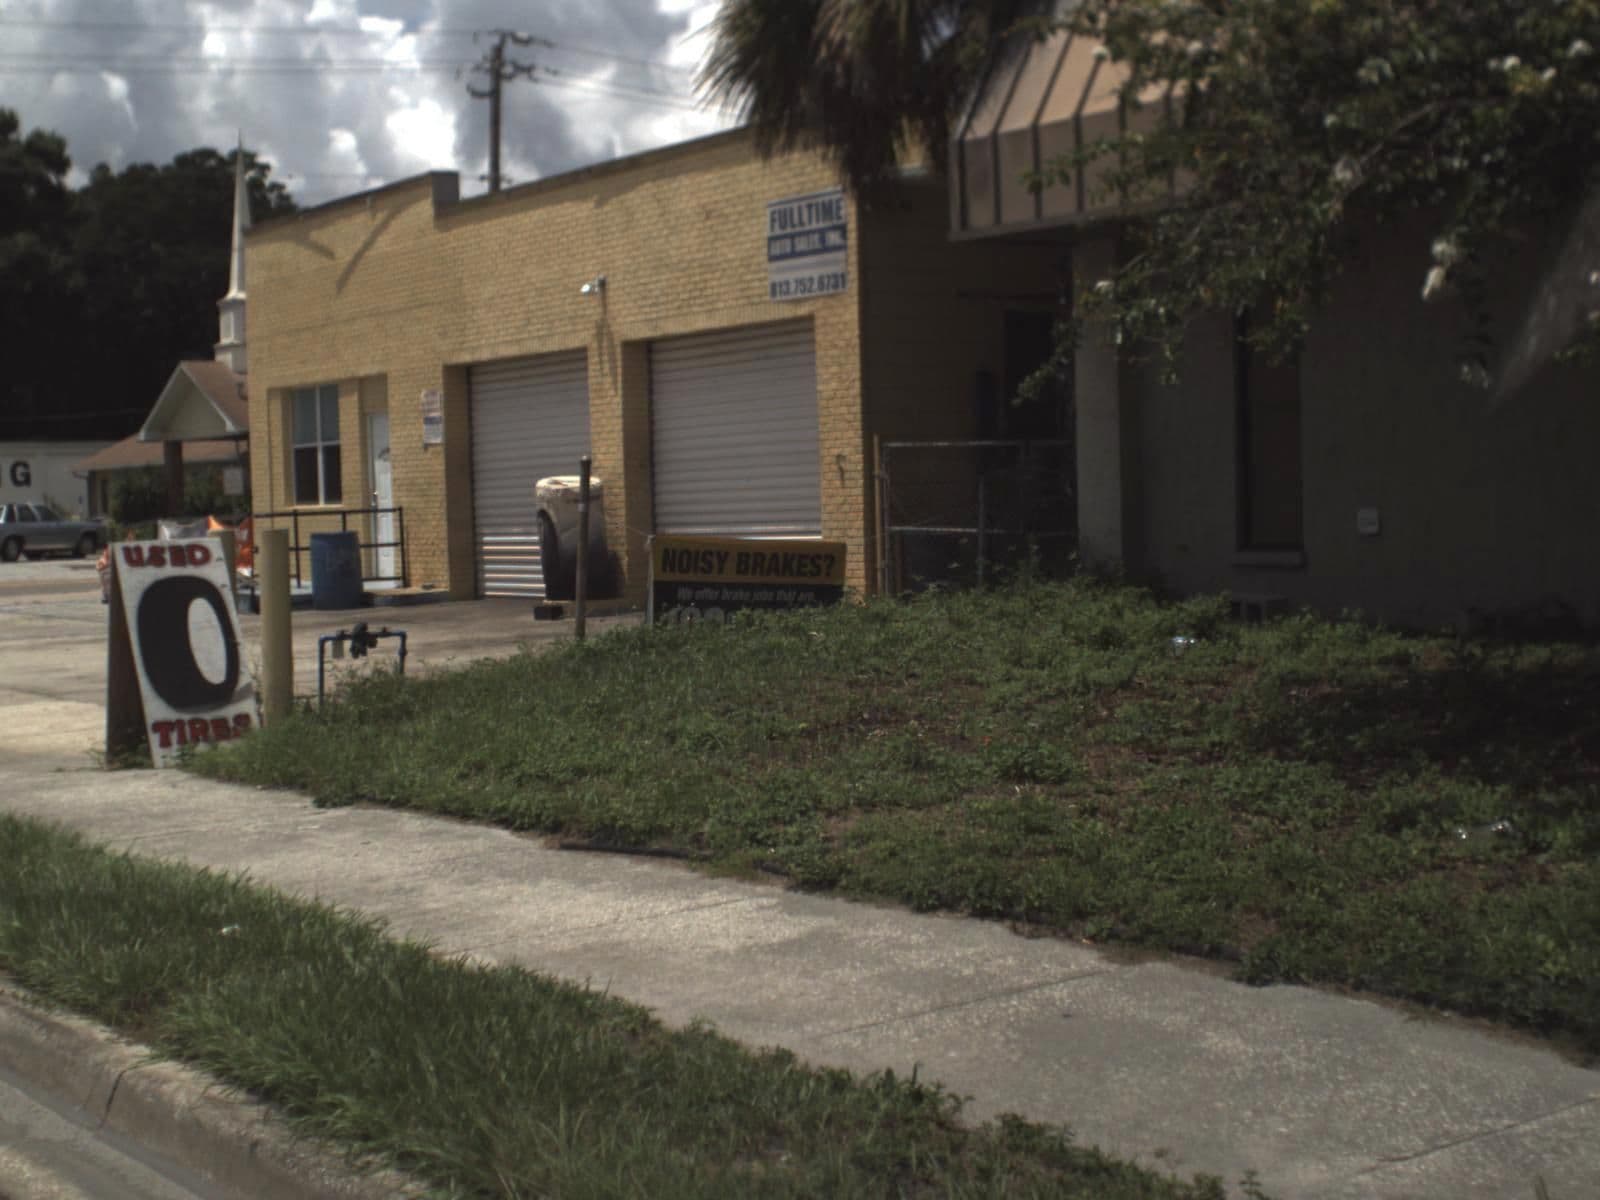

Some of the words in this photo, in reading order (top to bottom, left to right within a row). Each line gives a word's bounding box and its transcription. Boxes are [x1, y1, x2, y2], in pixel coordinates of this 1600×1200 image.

[770, 198, 843, 233] FULLTIME
[0, 461, 32, 488] G
[122, 543, 211, 568] USED
[662, 548, 729, 575] NOISY
[736, 552, 836, 577] BRAKES?
